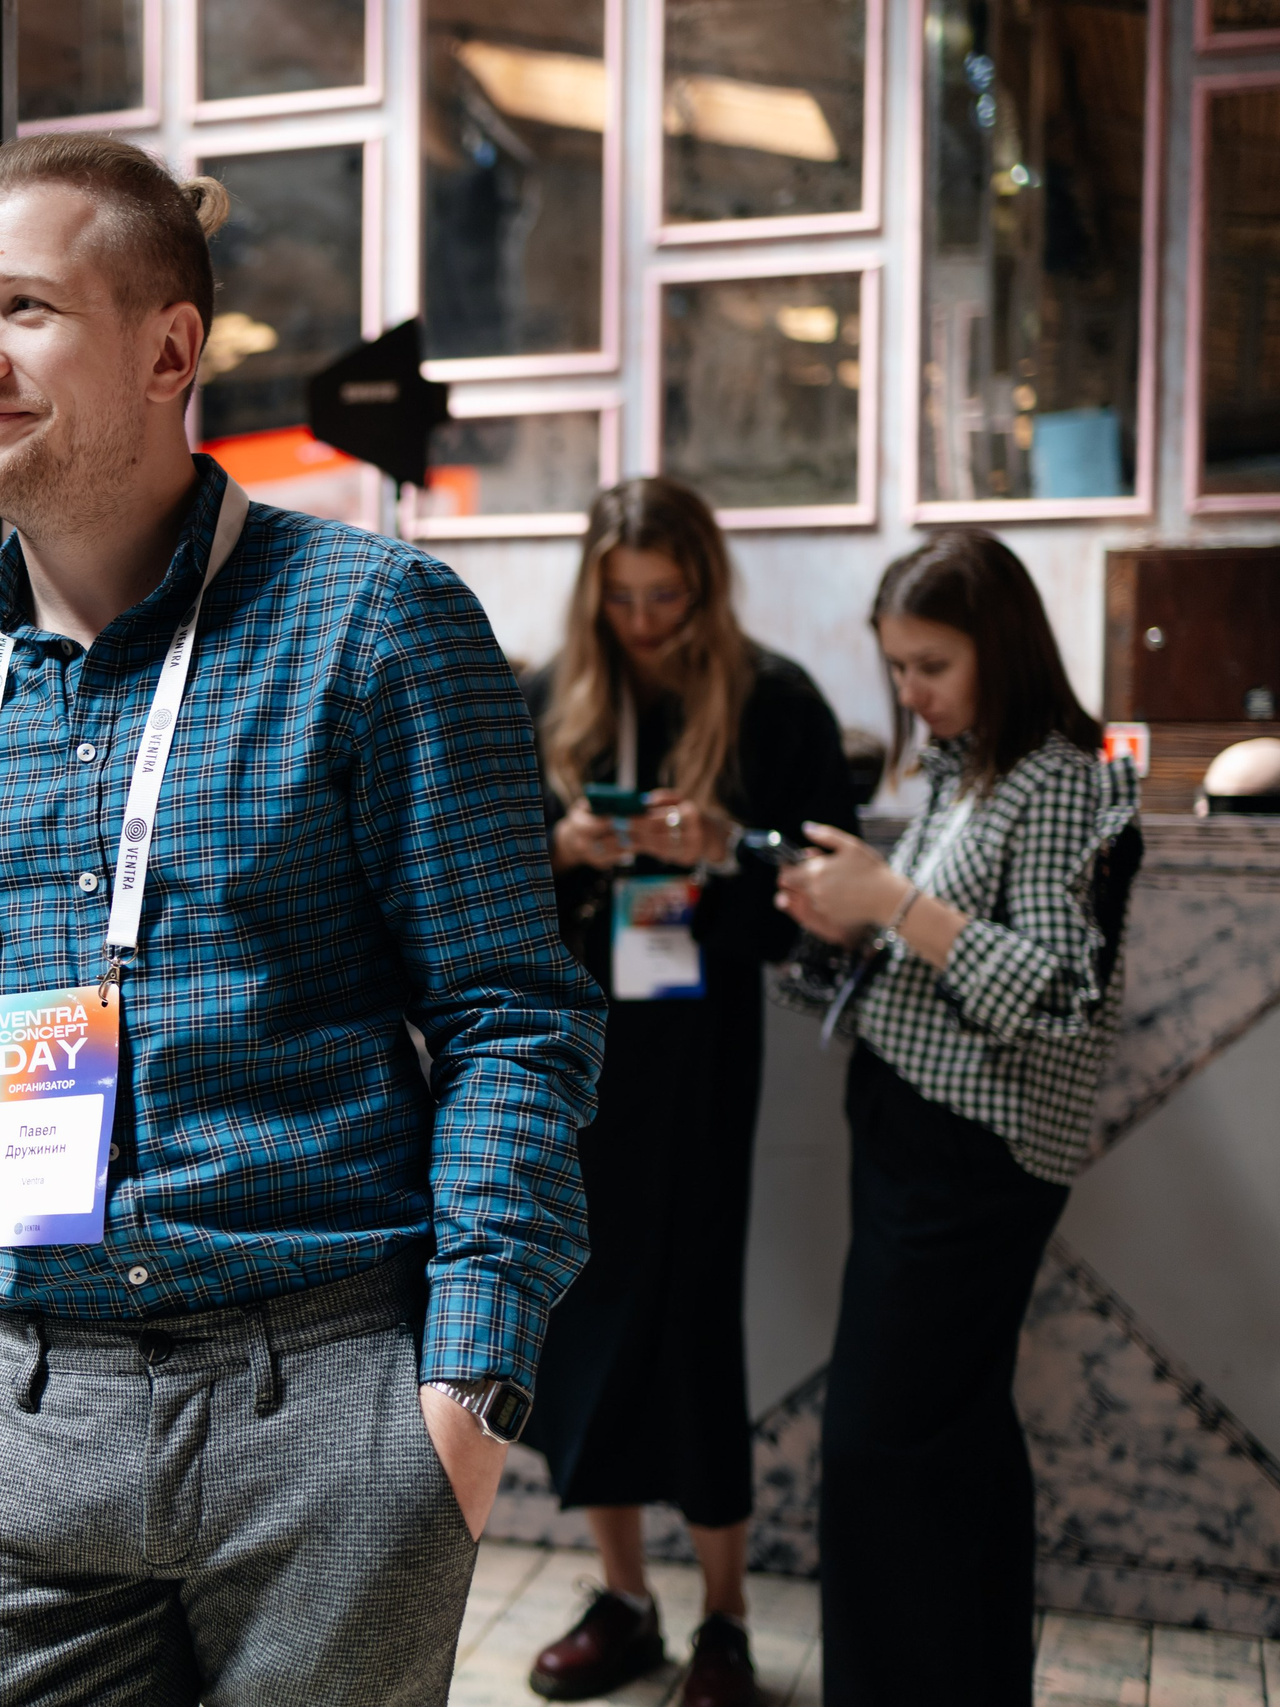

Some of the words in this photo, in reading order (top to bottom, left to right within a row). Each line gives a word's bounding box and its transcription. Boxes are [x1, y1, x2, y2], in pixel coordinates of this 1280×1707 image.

[170, 629, 189, 668] VENTRA
[142, 733, 163, 774] VENTRA
[121, 846, 139, 891] VENTRA
[8, 1080, 75, 1094] ОРГАНИЗАТОР
[19, 1125, 56, 1138] Павел
[5, 1143, 67, 1160] Дружинин
